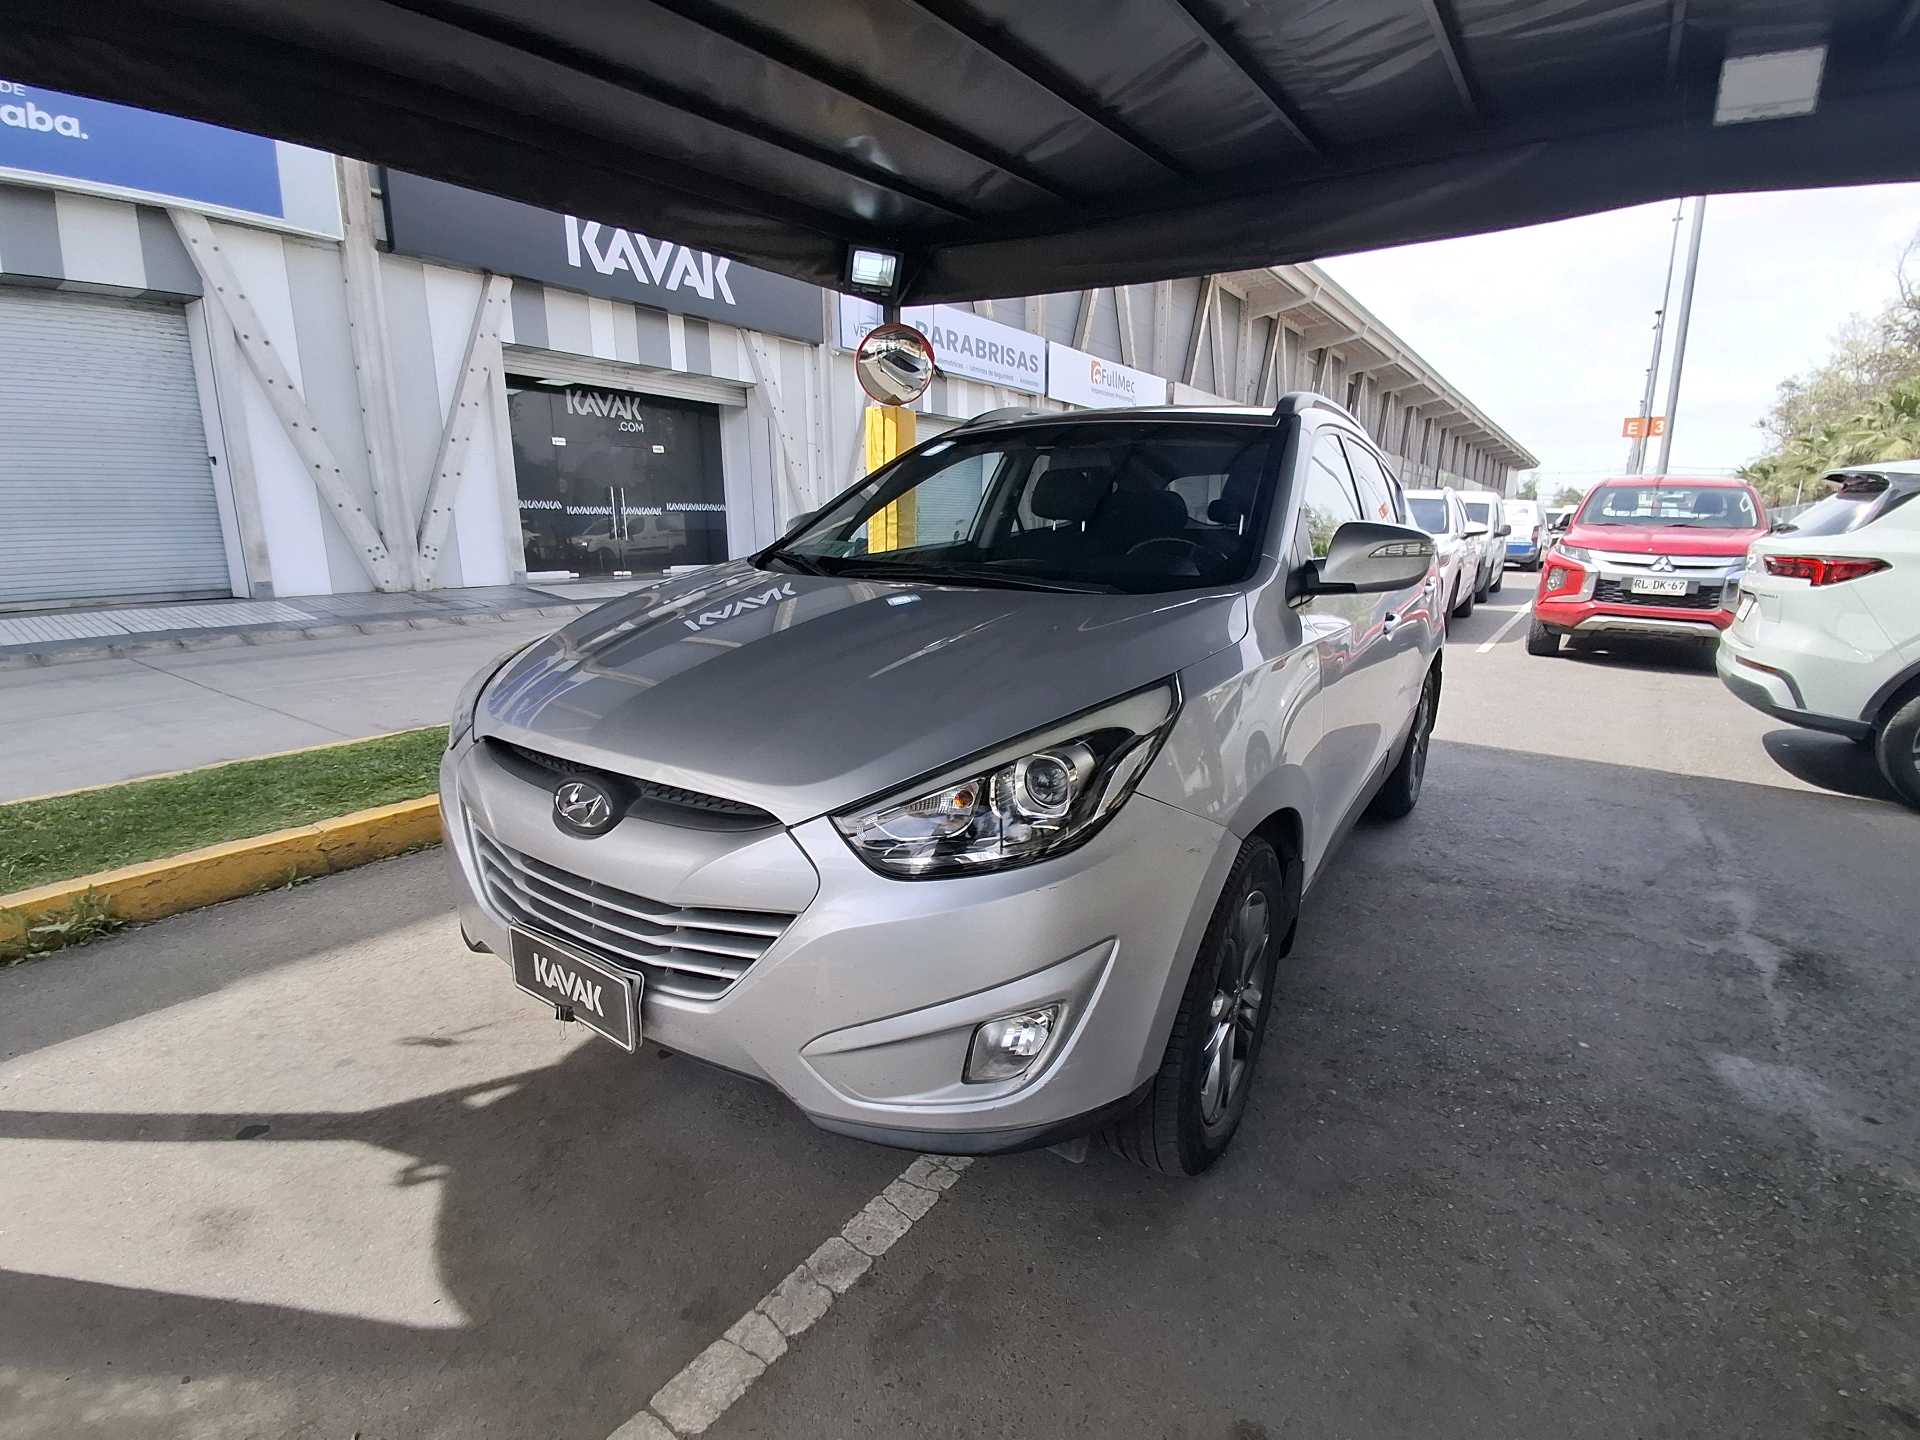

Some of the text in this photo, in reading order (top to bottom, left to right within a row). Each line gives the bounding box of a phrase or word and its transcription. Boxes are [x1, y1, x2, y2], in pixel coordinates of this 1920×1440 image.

[564, 214, 737, 306] KAVAK
[915, 320, 1040, 374] PARABRISAS
[1101, 368, 1136, 394] FullMec
[565, 389, 643, 421] KAVAK
[618, 421, 645, 433] .COM
[1626, 421, 1640, 435] E
[533, 952, 605, 1018] KAVAK
